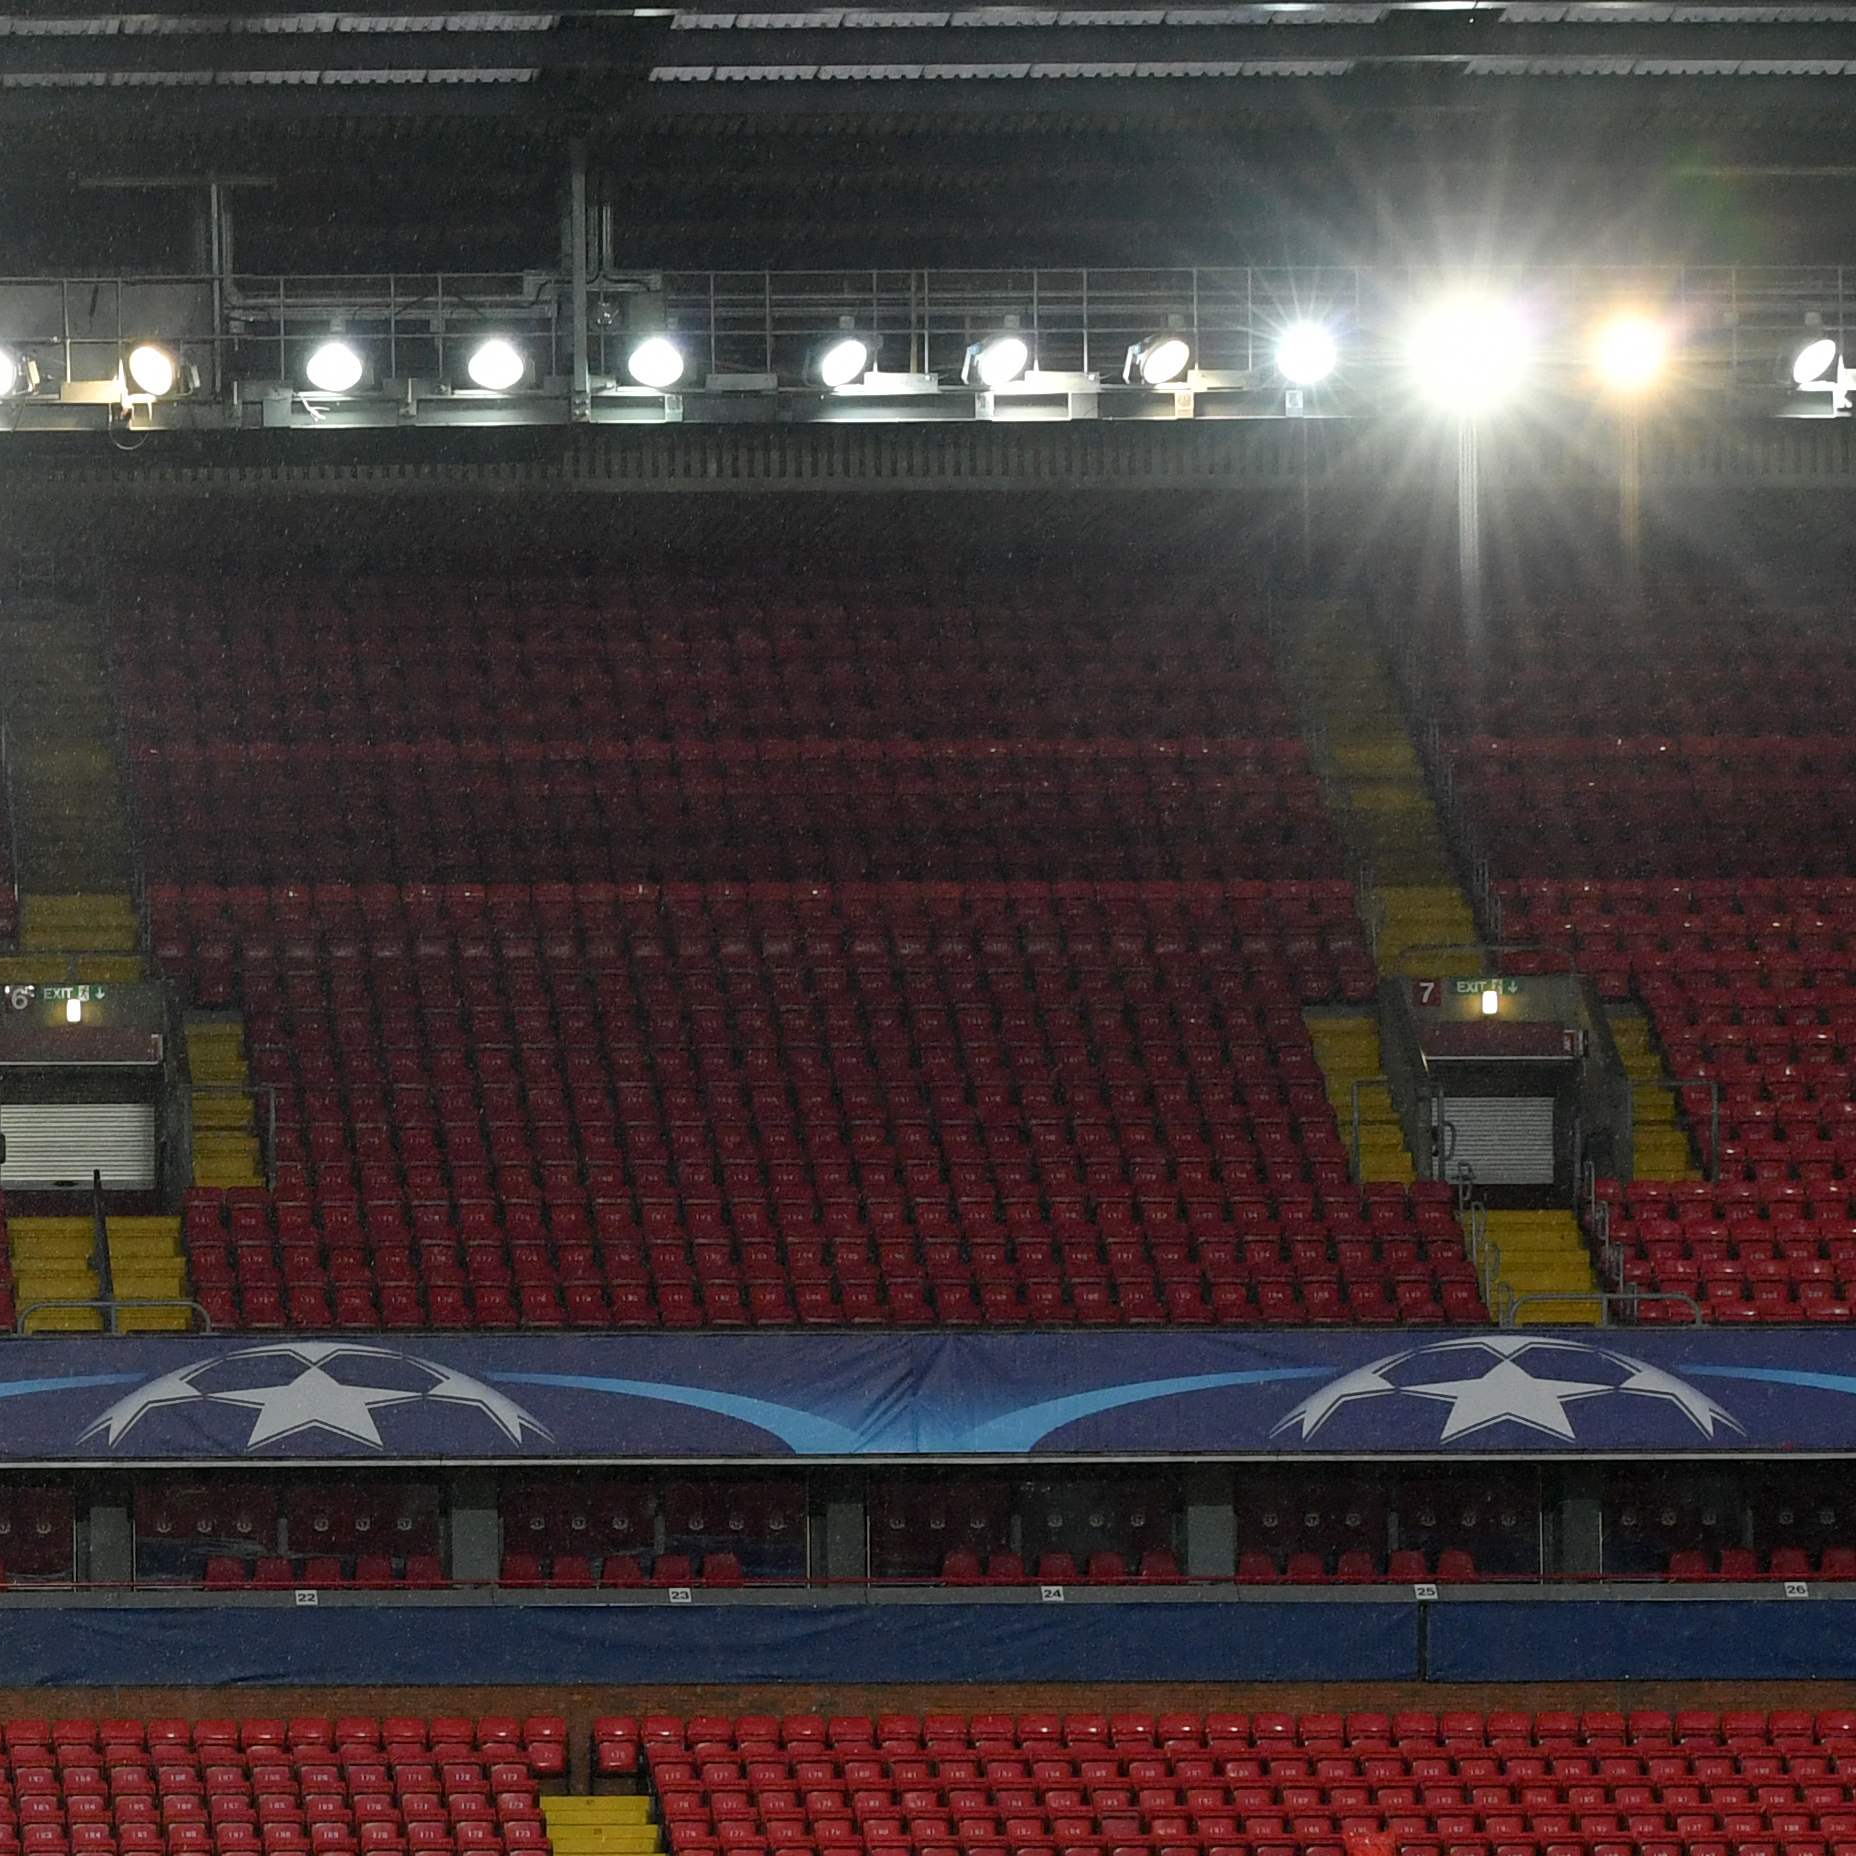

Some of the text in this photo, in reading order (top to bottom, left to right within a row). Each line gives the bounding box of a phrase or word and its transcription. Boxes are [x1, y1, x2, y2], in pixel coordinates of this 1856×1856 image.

[1456, 981, 1486, 993] EXIT
[44, 987, 73, 1000] EXIT
[1419, 982, 1435, 1003] 7
[11, 988, 28, 1010] 6
[1043, 1589, 1061, 1598] 24
[1416, 1587, 1435, 1596] 25
[1786, 1585, 1806, 1594] 26
[297, 1593, 315, 1602] 22
[671, 1591, 689, 1600] 23
